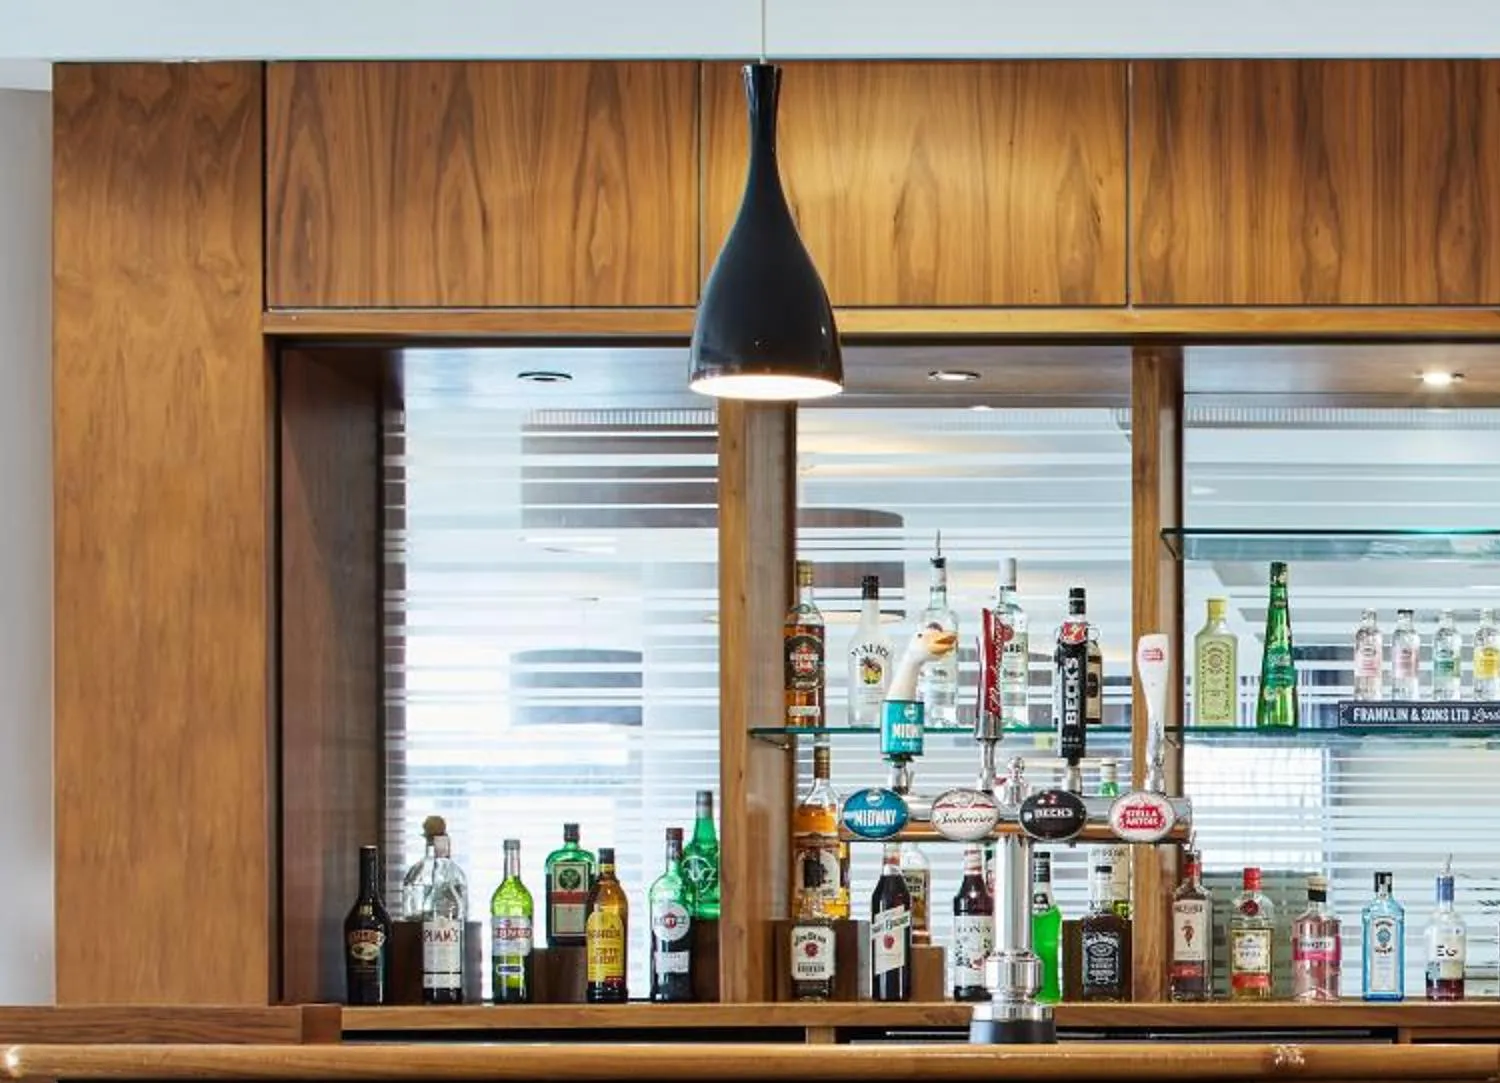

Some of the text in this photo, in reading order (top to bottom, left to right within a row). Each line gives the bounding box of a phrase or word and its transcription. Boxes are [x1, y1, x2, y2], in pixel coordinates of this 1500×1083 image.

[1353, 707, 1408, 722] FRANKLIN
[1410, 707, 1420, 722] &
[1422, 707, 1449, 722] SONS
[1451, 707, 1470, 722] LTD
